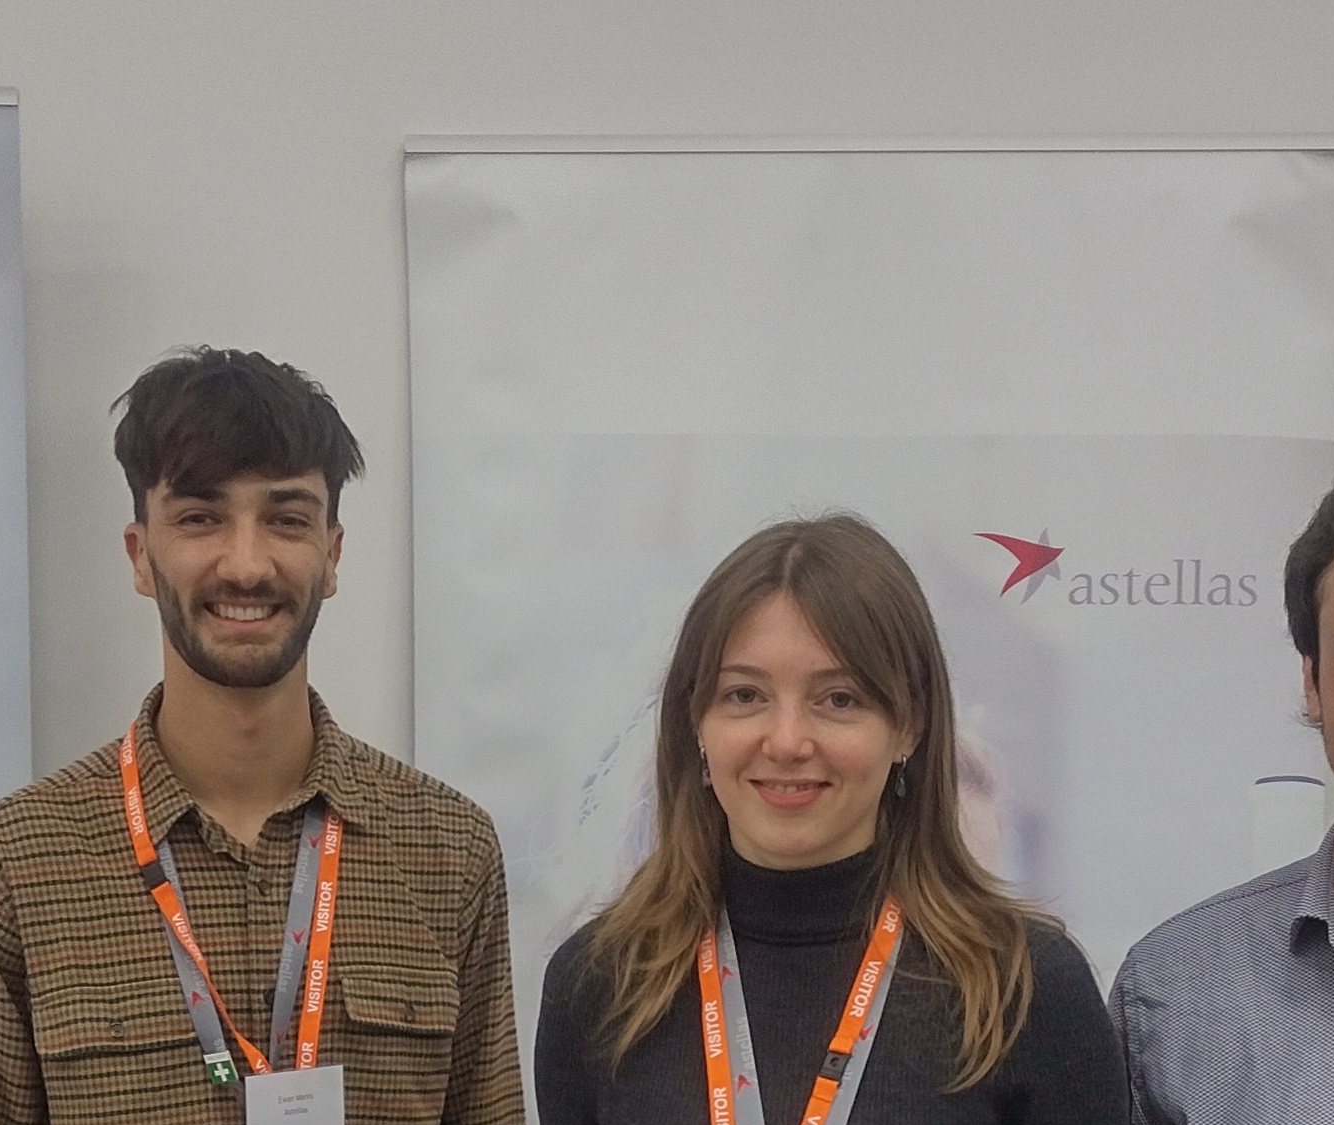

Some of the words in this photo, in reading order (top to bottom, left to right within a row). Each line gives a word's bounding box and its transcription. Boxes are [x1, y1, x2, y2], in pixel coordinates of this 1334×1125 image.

[1067, 558, 1259, 608] astellas
[127, 785, 145, 836] VISITOR
[324, 812, 341, 856] VISITO
[315, 880, 334, 934] VISITOR
[171, 911, 204, 963] VISITOR
[702, 932, 714, 974] VISIT
[306, 958, 325, 1013] VISITOR
[848, 960, 883, 1018] VISITOR
[704, 999, 724, 1059] VISITOR
[735, 1015, 756, 1072] astellas
